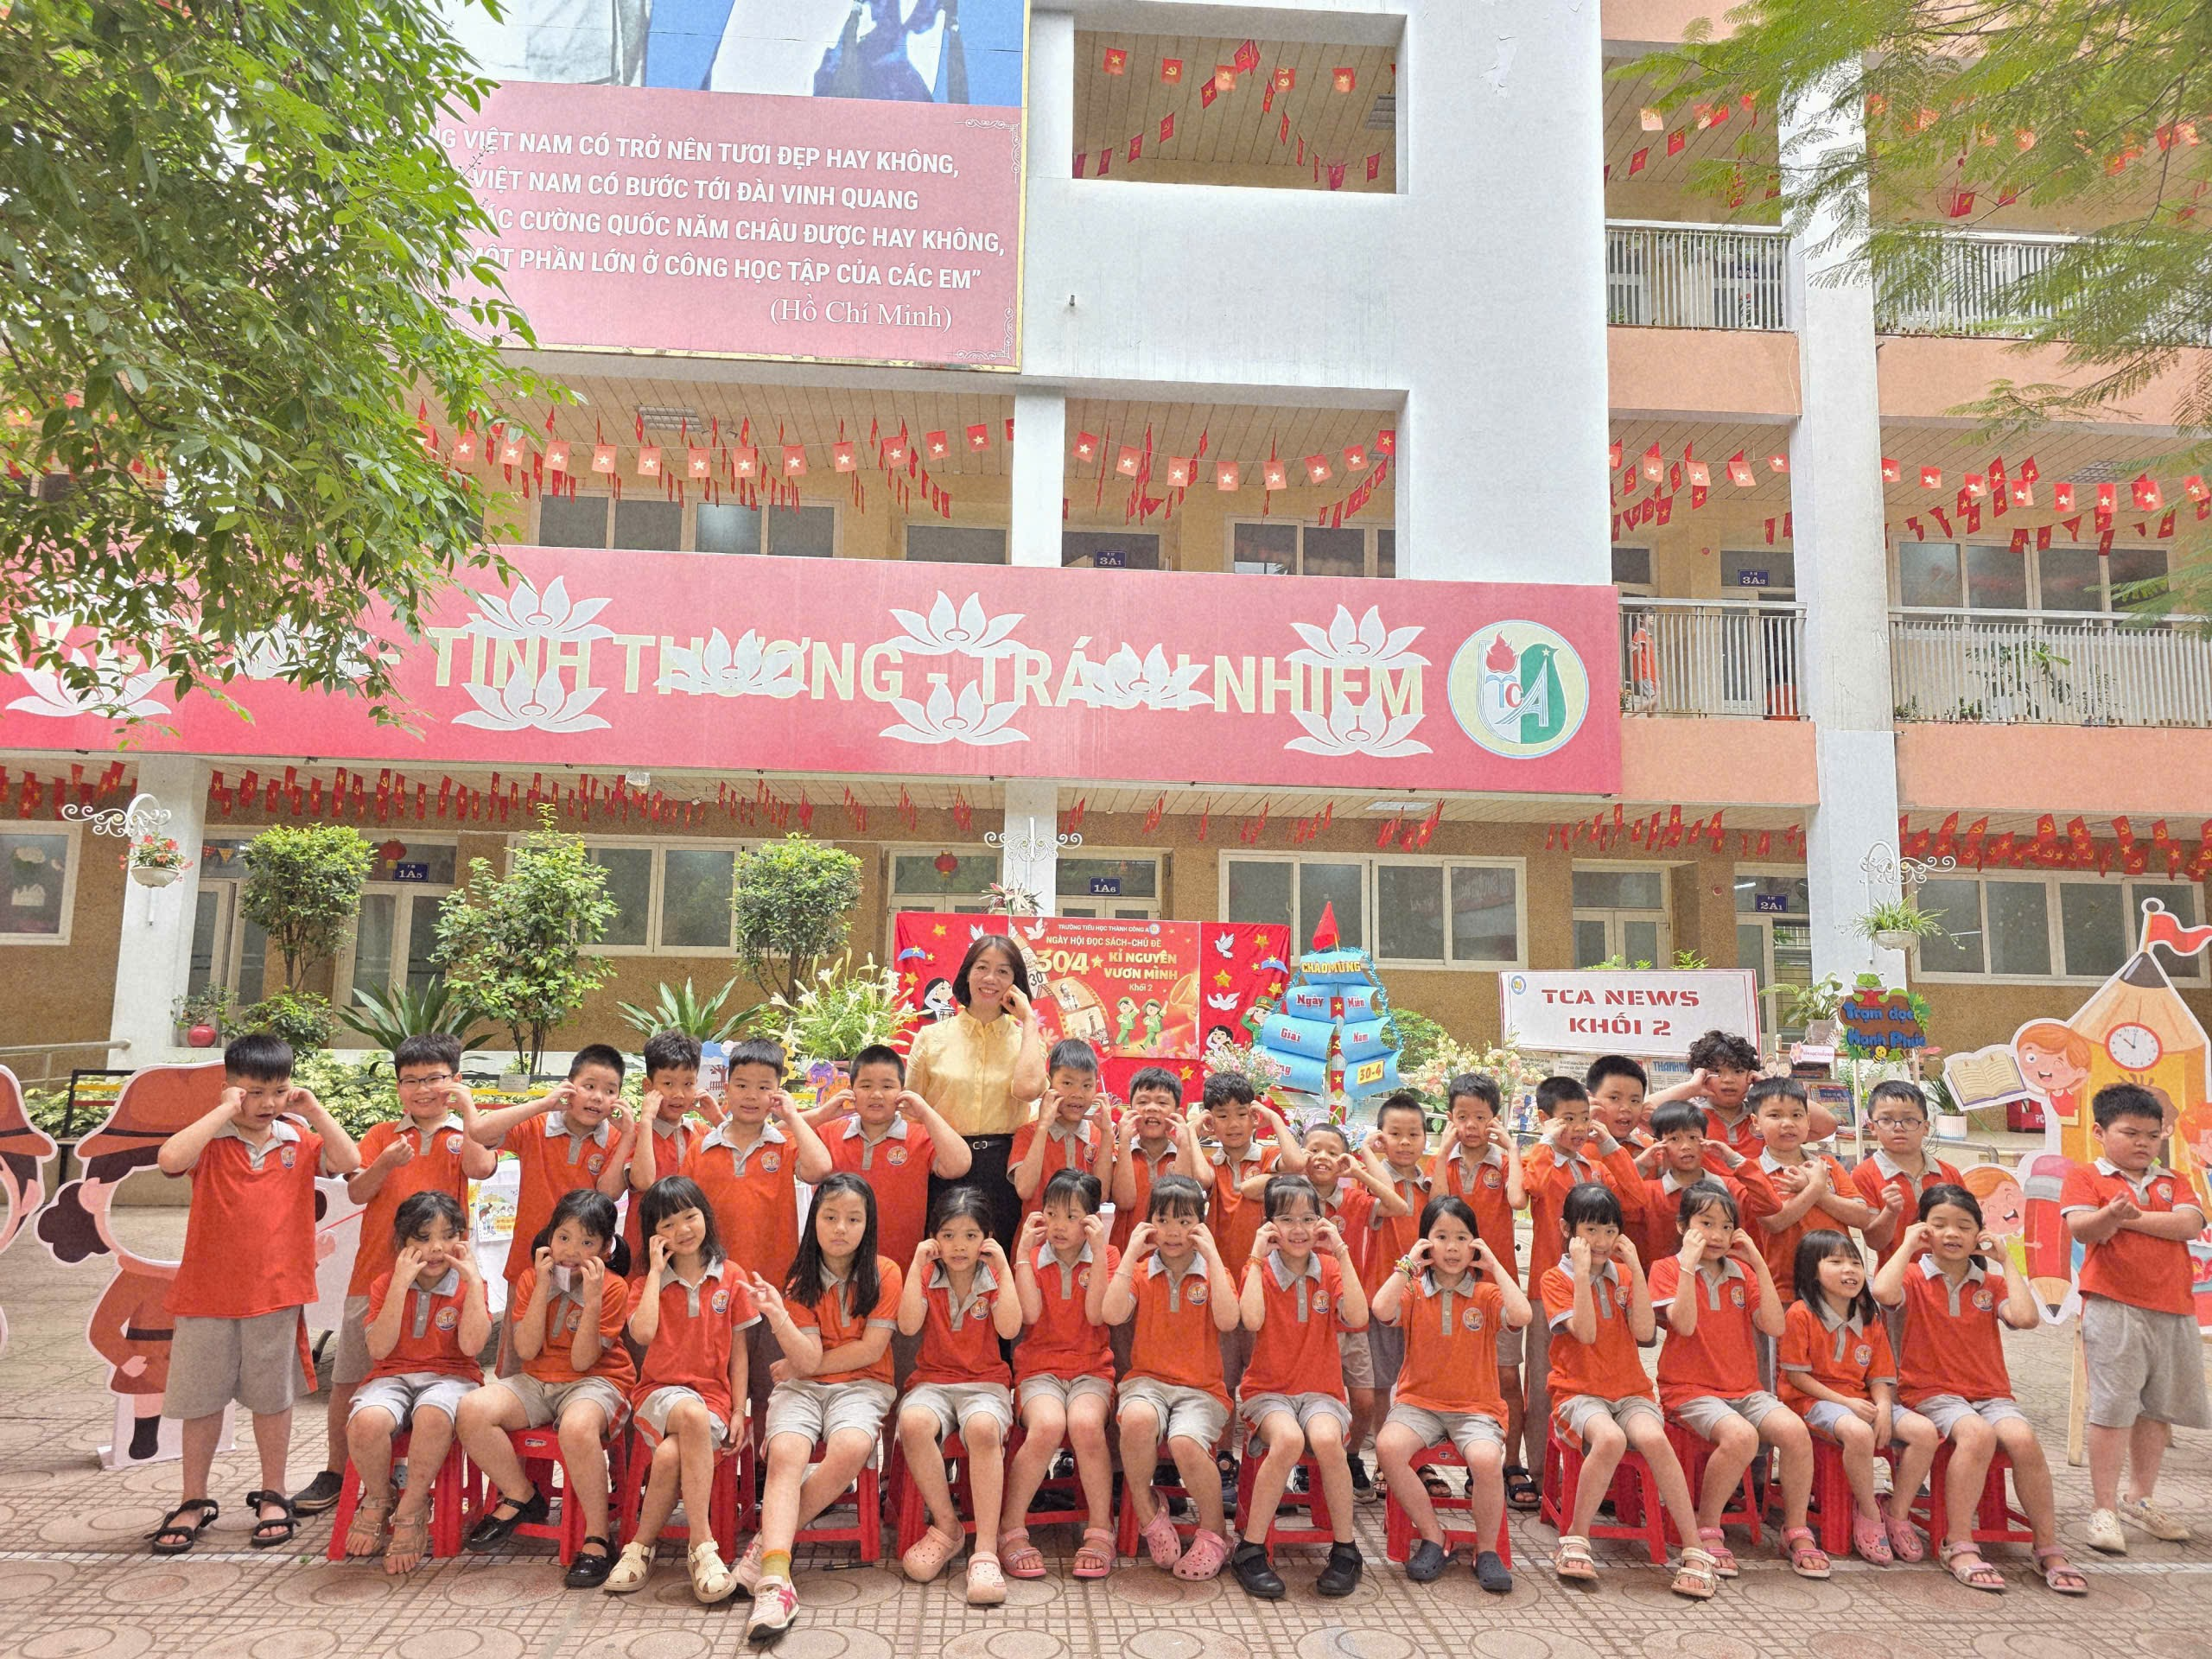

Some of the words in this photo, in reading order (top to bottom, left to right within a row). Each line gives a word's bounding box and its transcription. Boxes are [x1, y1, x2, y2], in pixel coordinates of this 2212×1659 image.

[463, 127, 513, 155] VIỆT
[519, 133, 572, 154] NAM
[579, 132, 609, 156] CÓ
[616, 134, 662, 159] TRỞ
[667, 137, 712, 162] NÊN
[718, 143, 770, 164] TƯƠI
[778, 147, 820, 170] ĐẸP
[827, 149, 870, 169] HAY
[877, 149, 958, 178] KHÔNG,
[473, 165, 523, 194] VIỆT
[529, 172, 582, 194] NAM
[588, 172, 619, 196] CÓ
[626, 174, 689, 199] BƯỚC
[694, 176, 730, 200] TỚI
[737, 178, 774, 203] ĐÀI
[781, 184, 836, 207] VINH
[842, 188, 918, 211] QUANG
[520, 207, 601, 233] CƯỜNG
[607, 211, 670, 236] QUỐC
[677, 214, 728, 239] NĂM
[735, 218, 797, 242] CHÂU
[803, 223, 866, 249] ĐƯỢC
[873, 227, 917, 249] HAY
[922, 226, 1005, 257] KHÔNG,
[520, 245, 584, 271] PHẦN
[591, 249, 636, 274] LỚN
[642, 249, 659, 275] Ở
[664, 251, 728, 277] CÔNG
[734, 258, 782, 284] HỌC
[787, 257, 830, 286] TẬP
[836, 258, 882, 286] CỦA
[888, 263, 932, 288] CÁC
[769, 294, 817, 326] (Hồ
[824, 300, 869, 323] Chí
[877, 302, 952, 332] Minh)
[969, 635, 1190, 710] TRÁ
[1094, 884, 1116, 893] 1A6
[1046, 935, 1068, 944] NGÀY
[1071, 936, 1084, 946] HỘI
[1086, 937, 1103, 947] ĐỌC
[1151, 938, 1161, 948] ĐỀ
[1036, 950, 1090, 976] 30/4
[1126, 950, 1177, 964] NGUYÊN
[1103, 967, 1141, 979] VƯƠN
[1144, 965, 1178, 980] MÌNH
[1129, 983, 1146, 992] Khối
[1297, 995, 1324, 1007] Ngày
[1541, 989, 1596, 1005] TCA
[1605, 990, 1700, 1007] NEWS
[1842, 1001, 1883, 1023] Trạm
[1569, 1012, 1642, 1035] KHỐI
[1653, 1020, 1671, 1036] 2
[1353, 1033, 1369, 1043] Nam
[1359, 1064, 1381, 1081] 30-4
